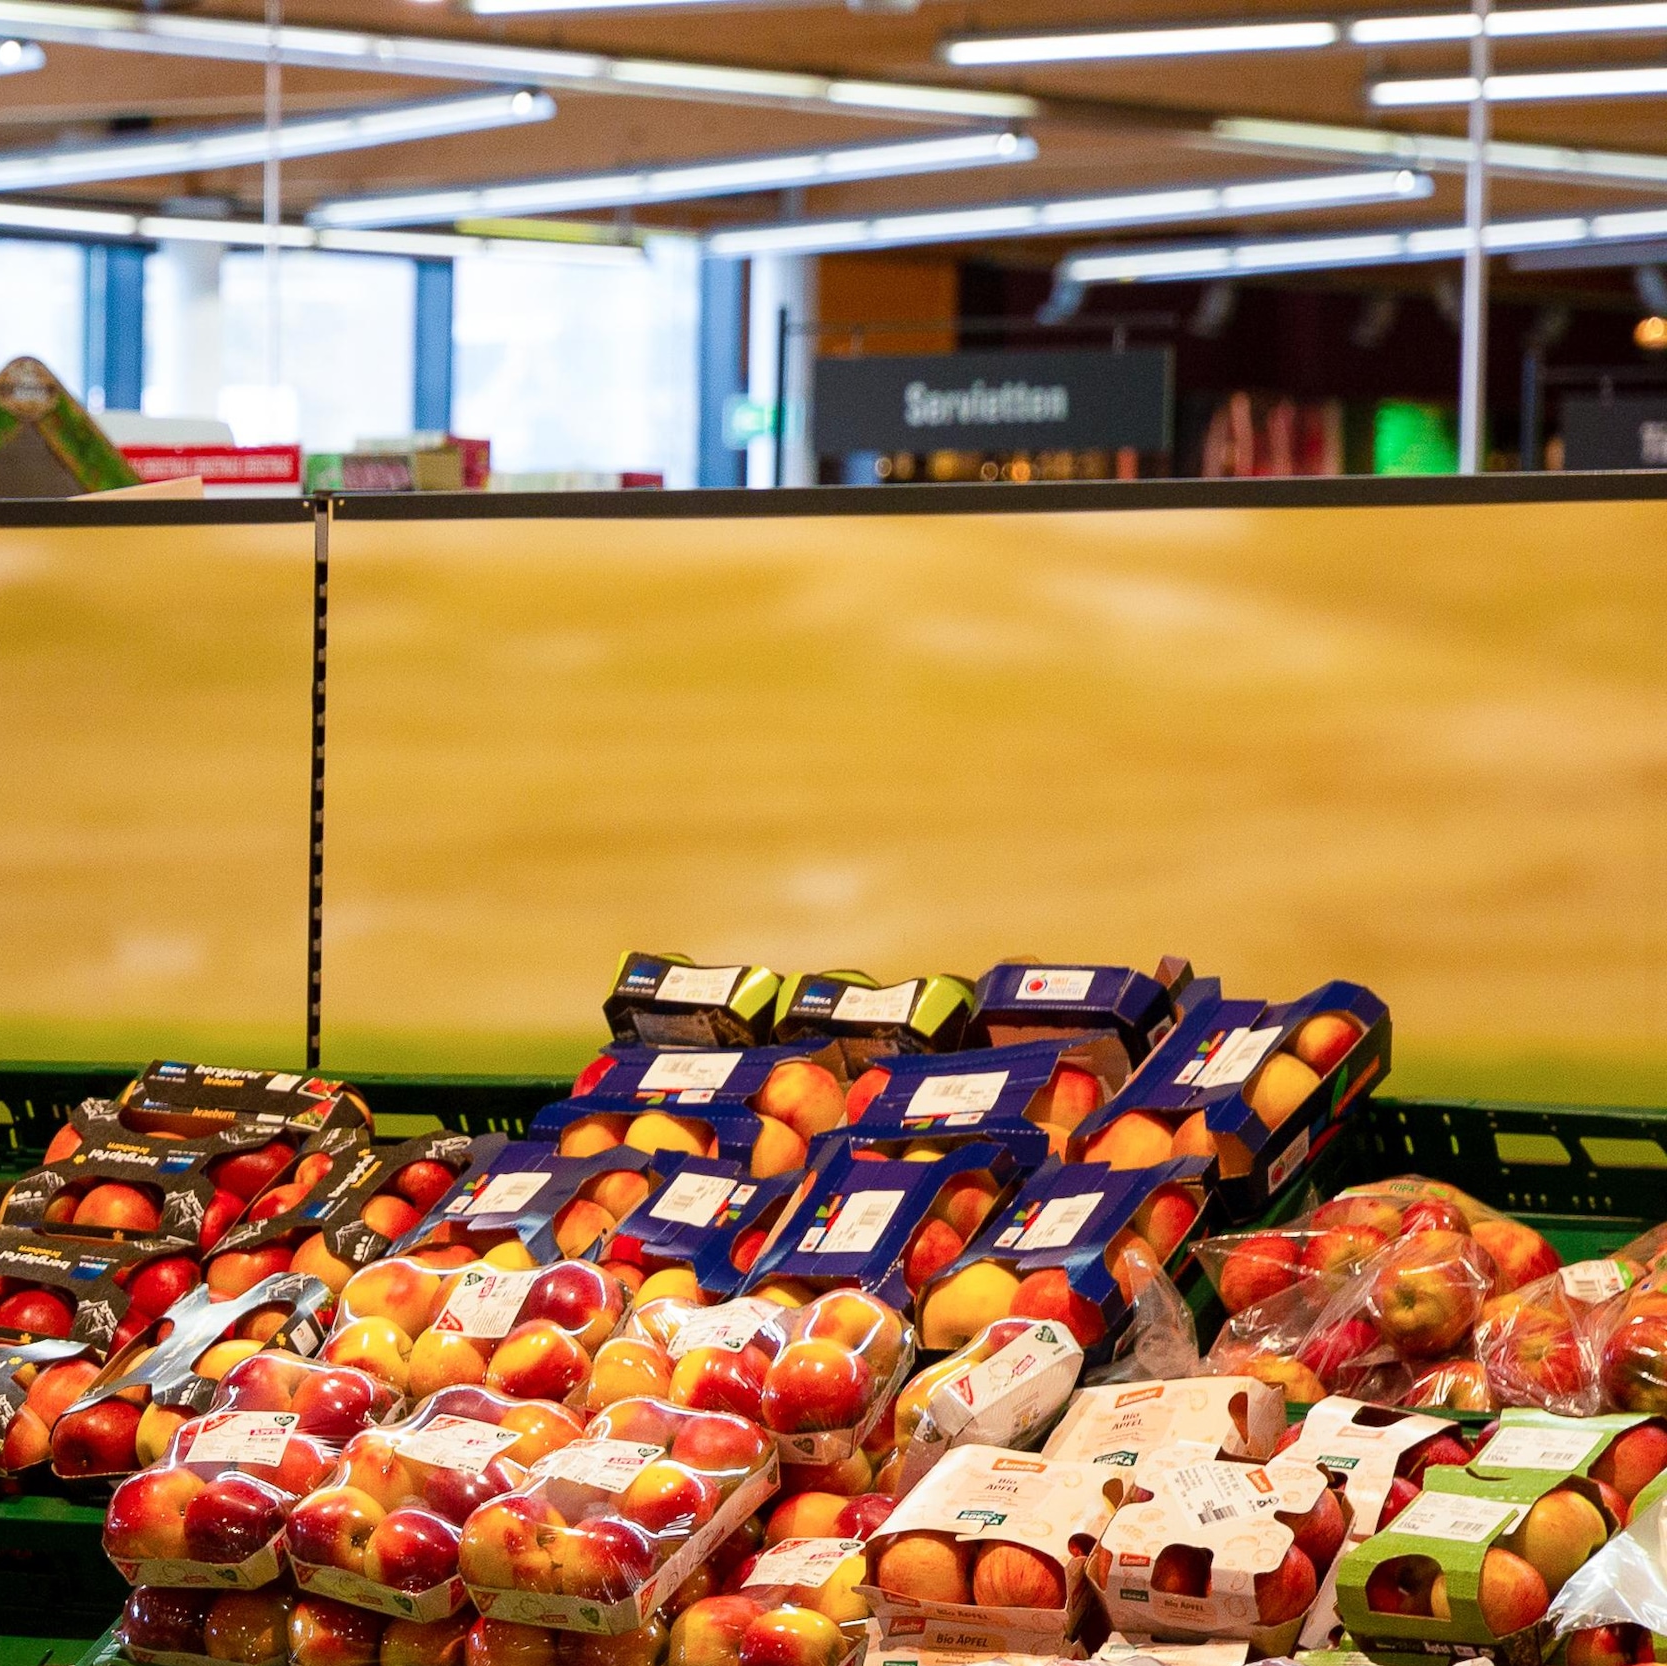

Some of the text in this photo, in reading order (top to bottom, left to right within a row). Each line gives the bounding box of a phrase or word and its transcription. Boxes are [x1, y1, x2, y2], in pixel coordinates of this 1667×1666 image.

[903, 379, 1068, 427] Servietten
[936, 1632, 989, 1648] Bio ÄPFEL
